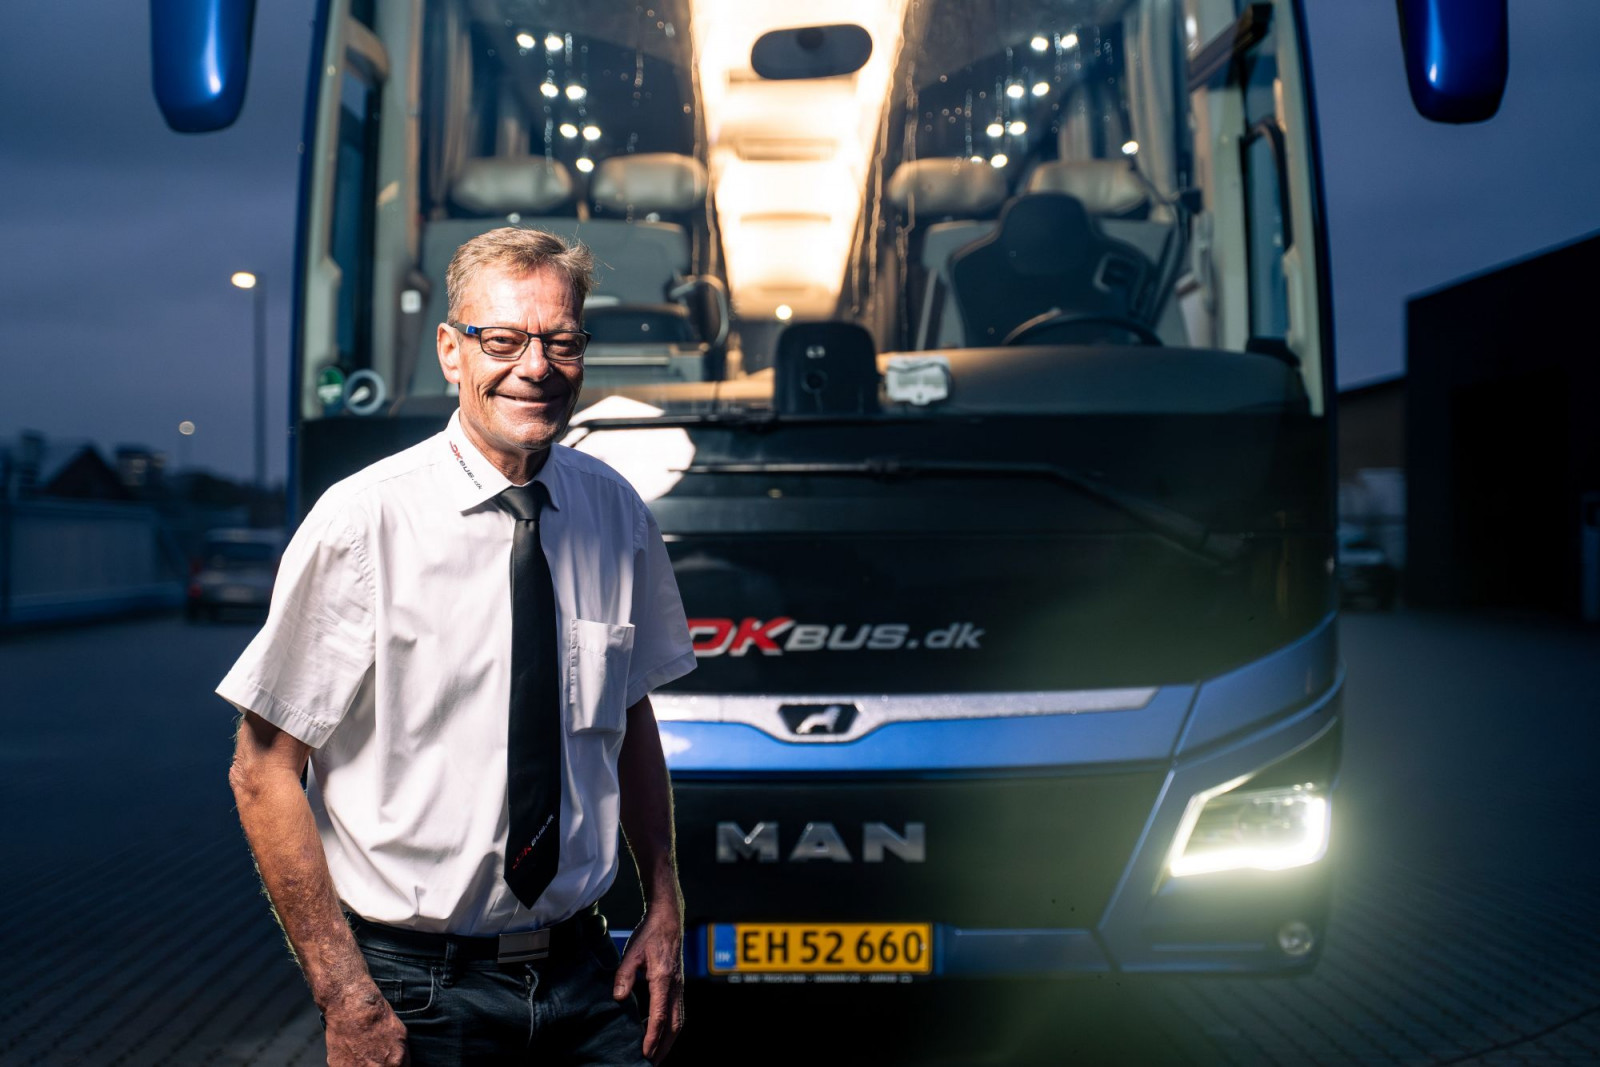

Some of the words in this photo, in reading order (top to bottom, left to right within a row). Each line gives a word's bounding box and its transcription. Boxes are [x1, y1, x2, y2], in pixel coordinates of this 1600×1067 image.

[716, 821, 926, 862] MAN
[742, 930, 789, 964] EH
[801, 930, 844, 964] 52
[855, 930, 922, 964] 660
